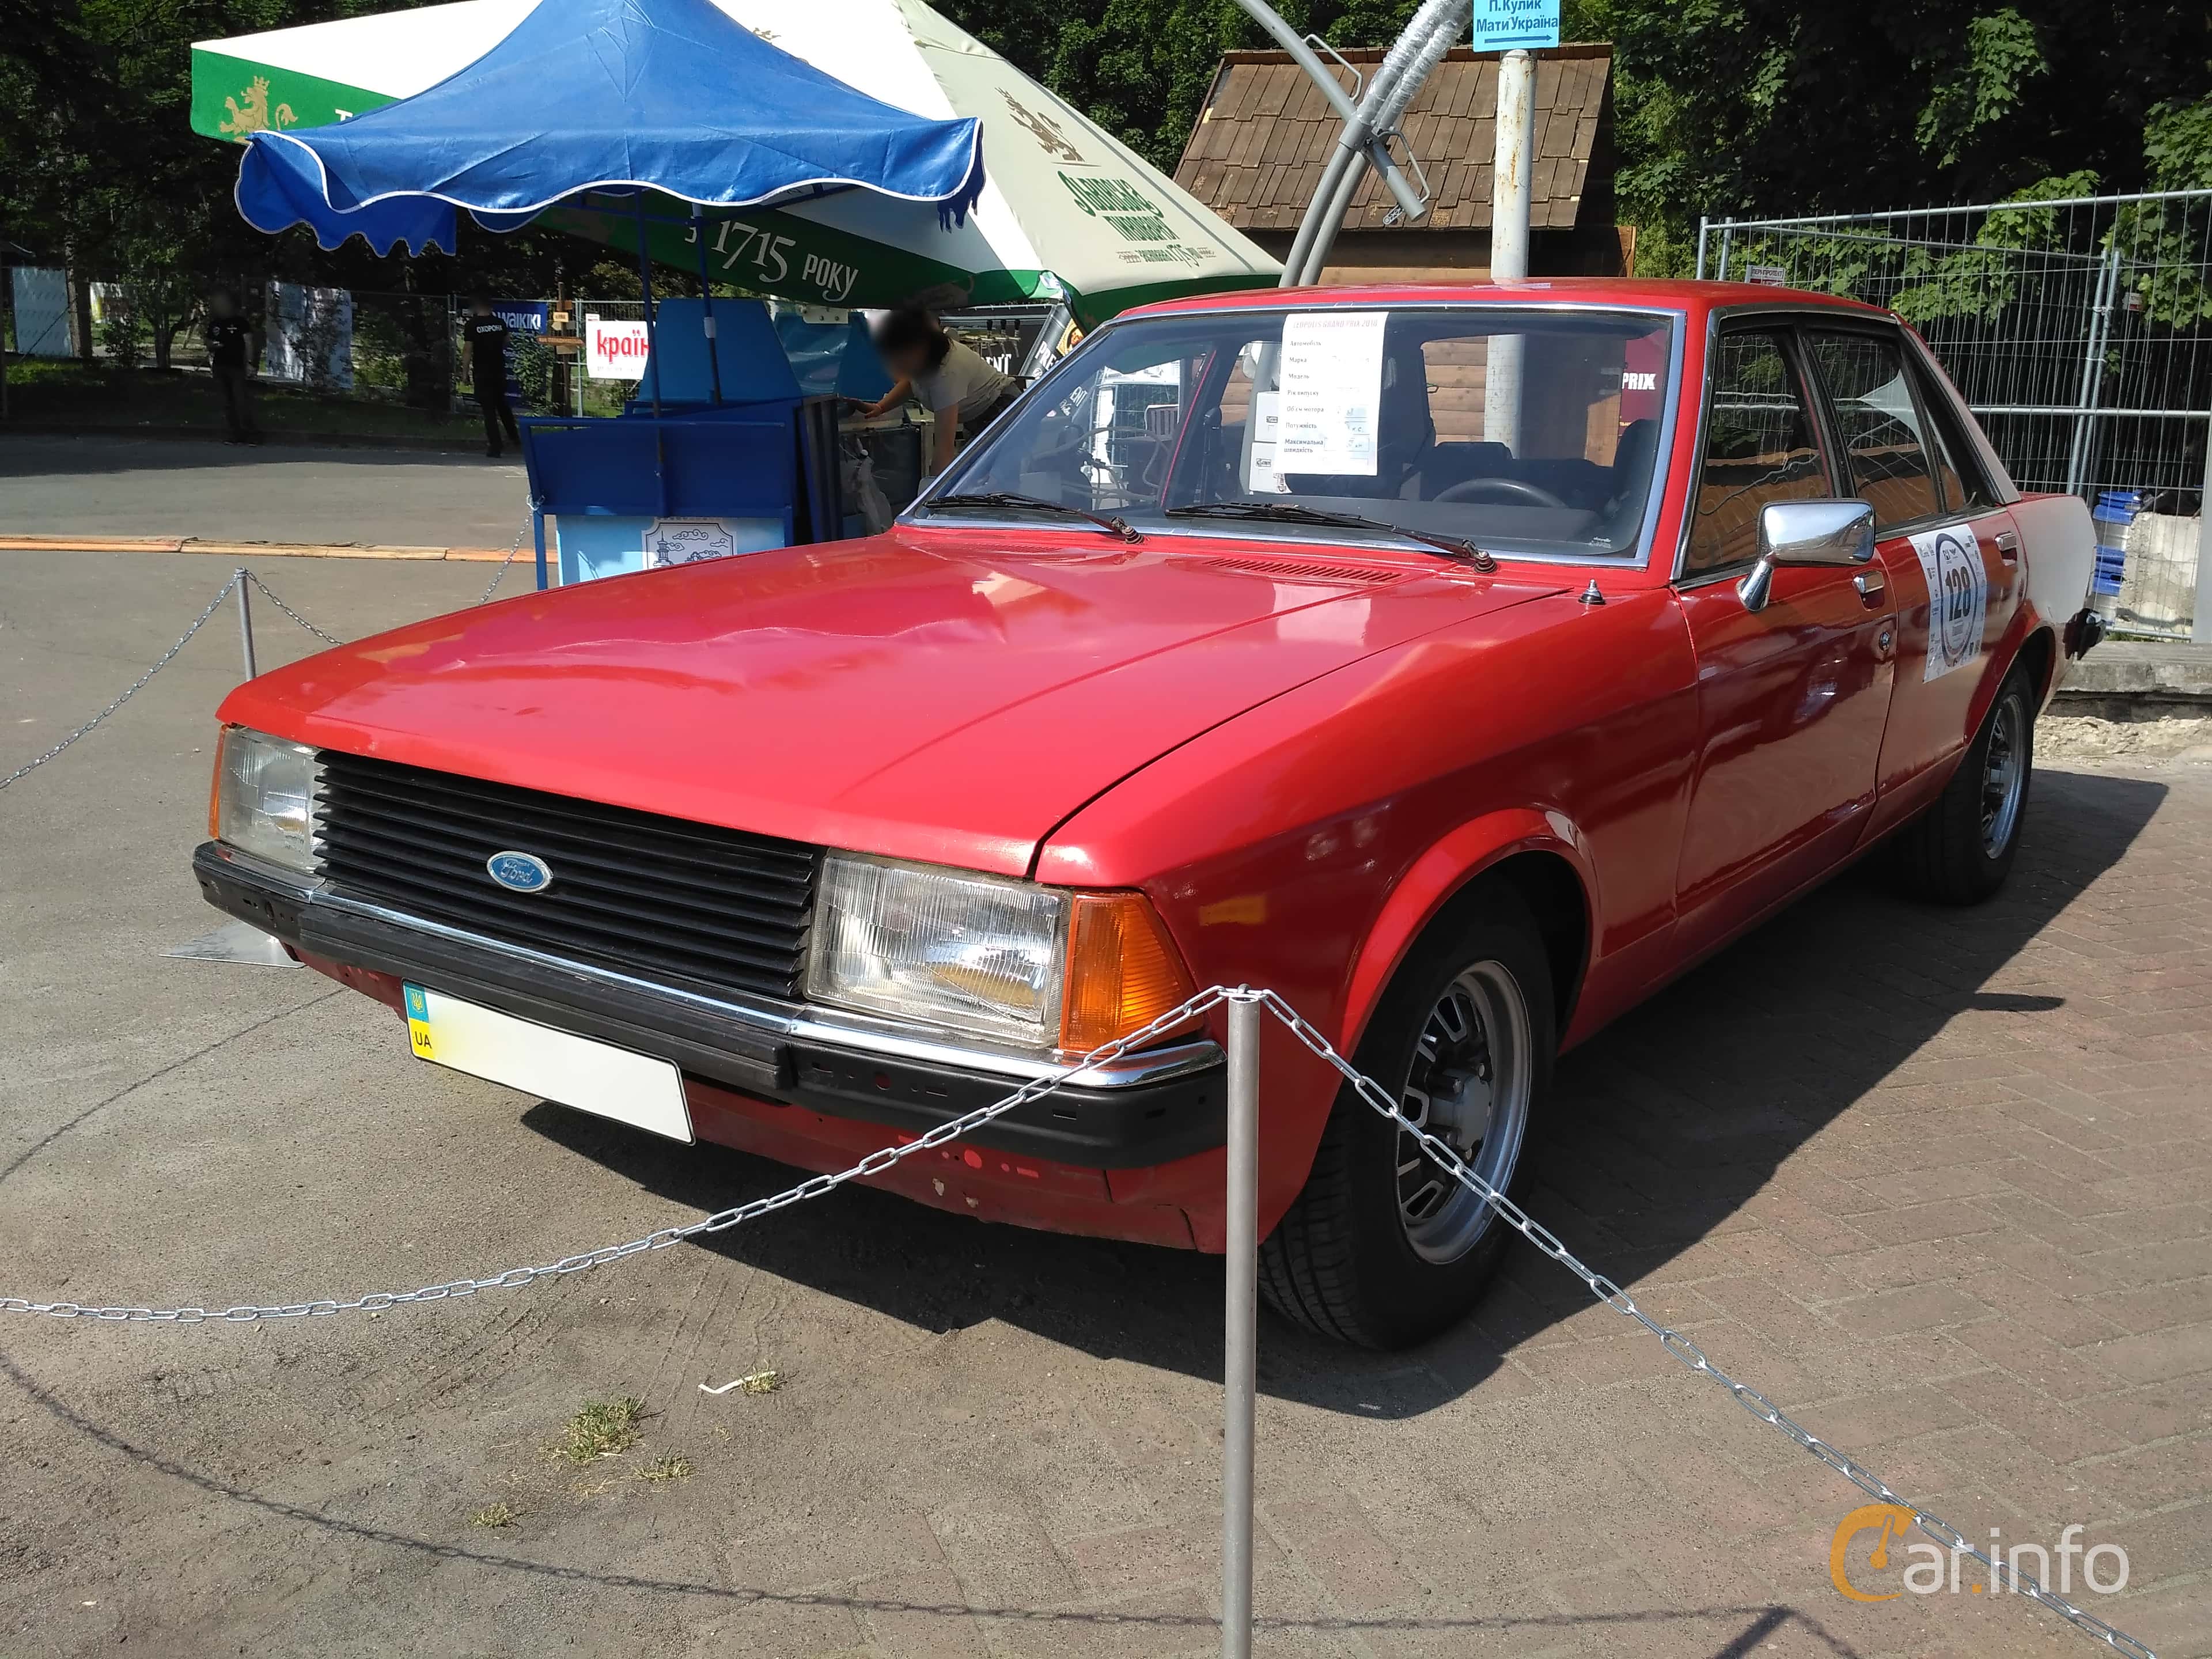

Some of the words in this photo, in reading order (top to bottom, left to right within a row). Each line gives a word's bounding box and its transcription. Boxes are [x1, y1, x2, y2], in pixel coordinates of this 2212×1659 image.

[1489, 0, 1541, 14] П.Кулик
[1476, 18, 1509, 32] Мати
[1511, 15, 1558, 32] Україна
[711, 220, 797, 283] 1715
[802, 253, 858, 302] РОКУ
[476, 325, 503, 333] ОХОРОНА
[1622, 372, 1656, 390] PRIX
[1286, 422, 1317, 430] Потужність
[500, 858, 536, 883] Ford
[415, 1032, 432, 1049] UA
